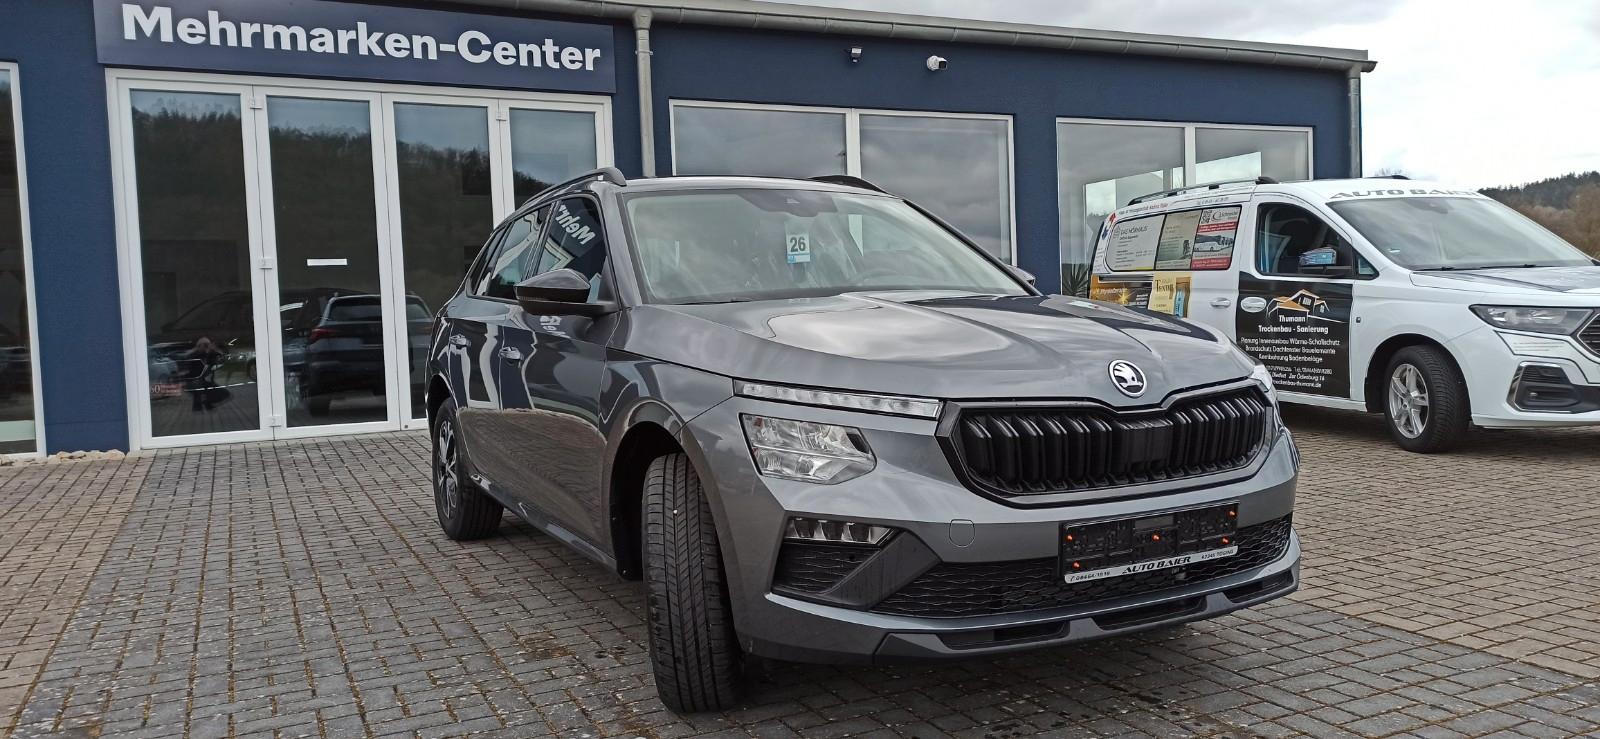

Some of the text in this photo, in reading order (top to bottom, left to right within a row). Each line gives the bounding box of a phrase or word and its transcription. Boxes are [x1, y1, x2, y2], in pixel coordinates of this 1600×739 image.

[122, 3, 600, 71] Mehrmarken-Center
[1330, 189, 1404, 199] AUTO
[789, 236, 806, 252] 26
[1258, 325, 1292, 333] Trockenbau
[1296, 325, 1329, 334] Sanierung
[1241, 337, 1258, 345] Planung
[1272, 345, 1301, 353] Dachfenster
[1122, 563, 1155, 575] AUTO
[1156, 556, 1191, 568] BAIER
